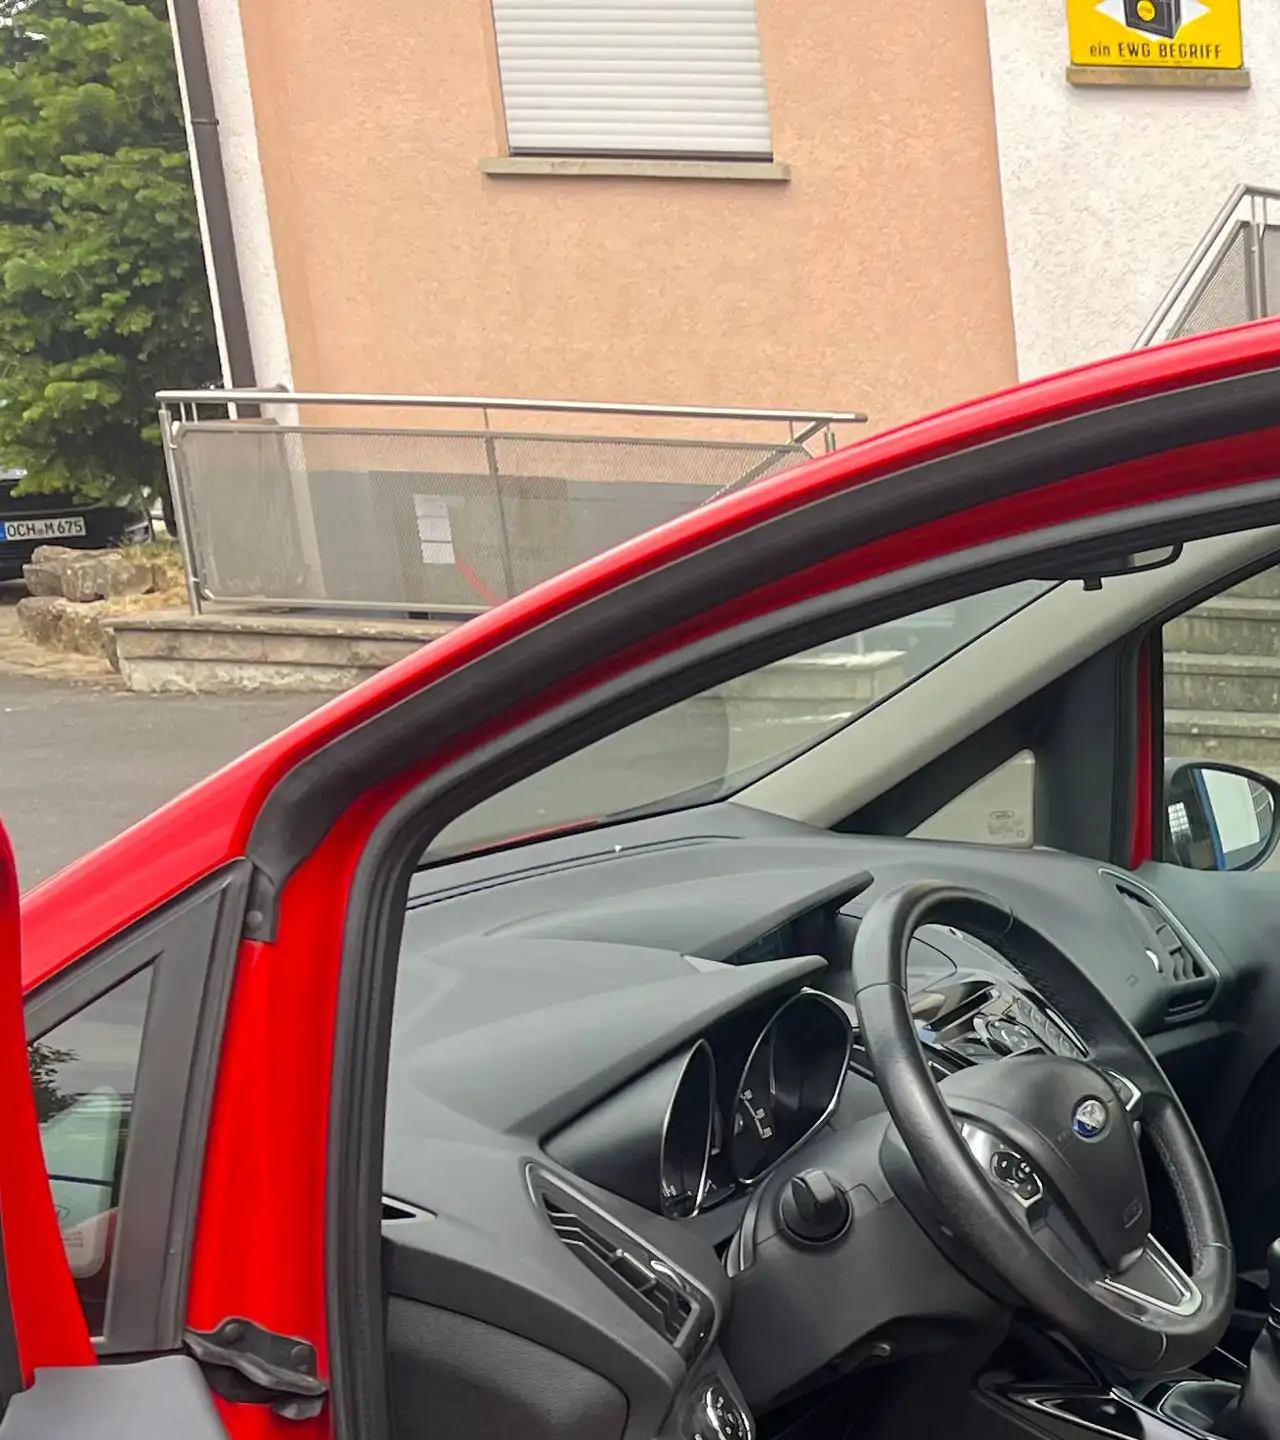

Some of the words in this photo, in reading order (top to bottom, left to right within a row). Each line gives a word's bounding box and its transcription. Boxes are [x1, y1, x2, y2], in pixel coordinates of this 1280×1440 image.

[1090, 42, 1110, 57] ein
[1118, 43, 1151, 58] EWG
[1159, 43, 1222, 59] BEGRIFF
[7, 522, 36, 537] OCH
